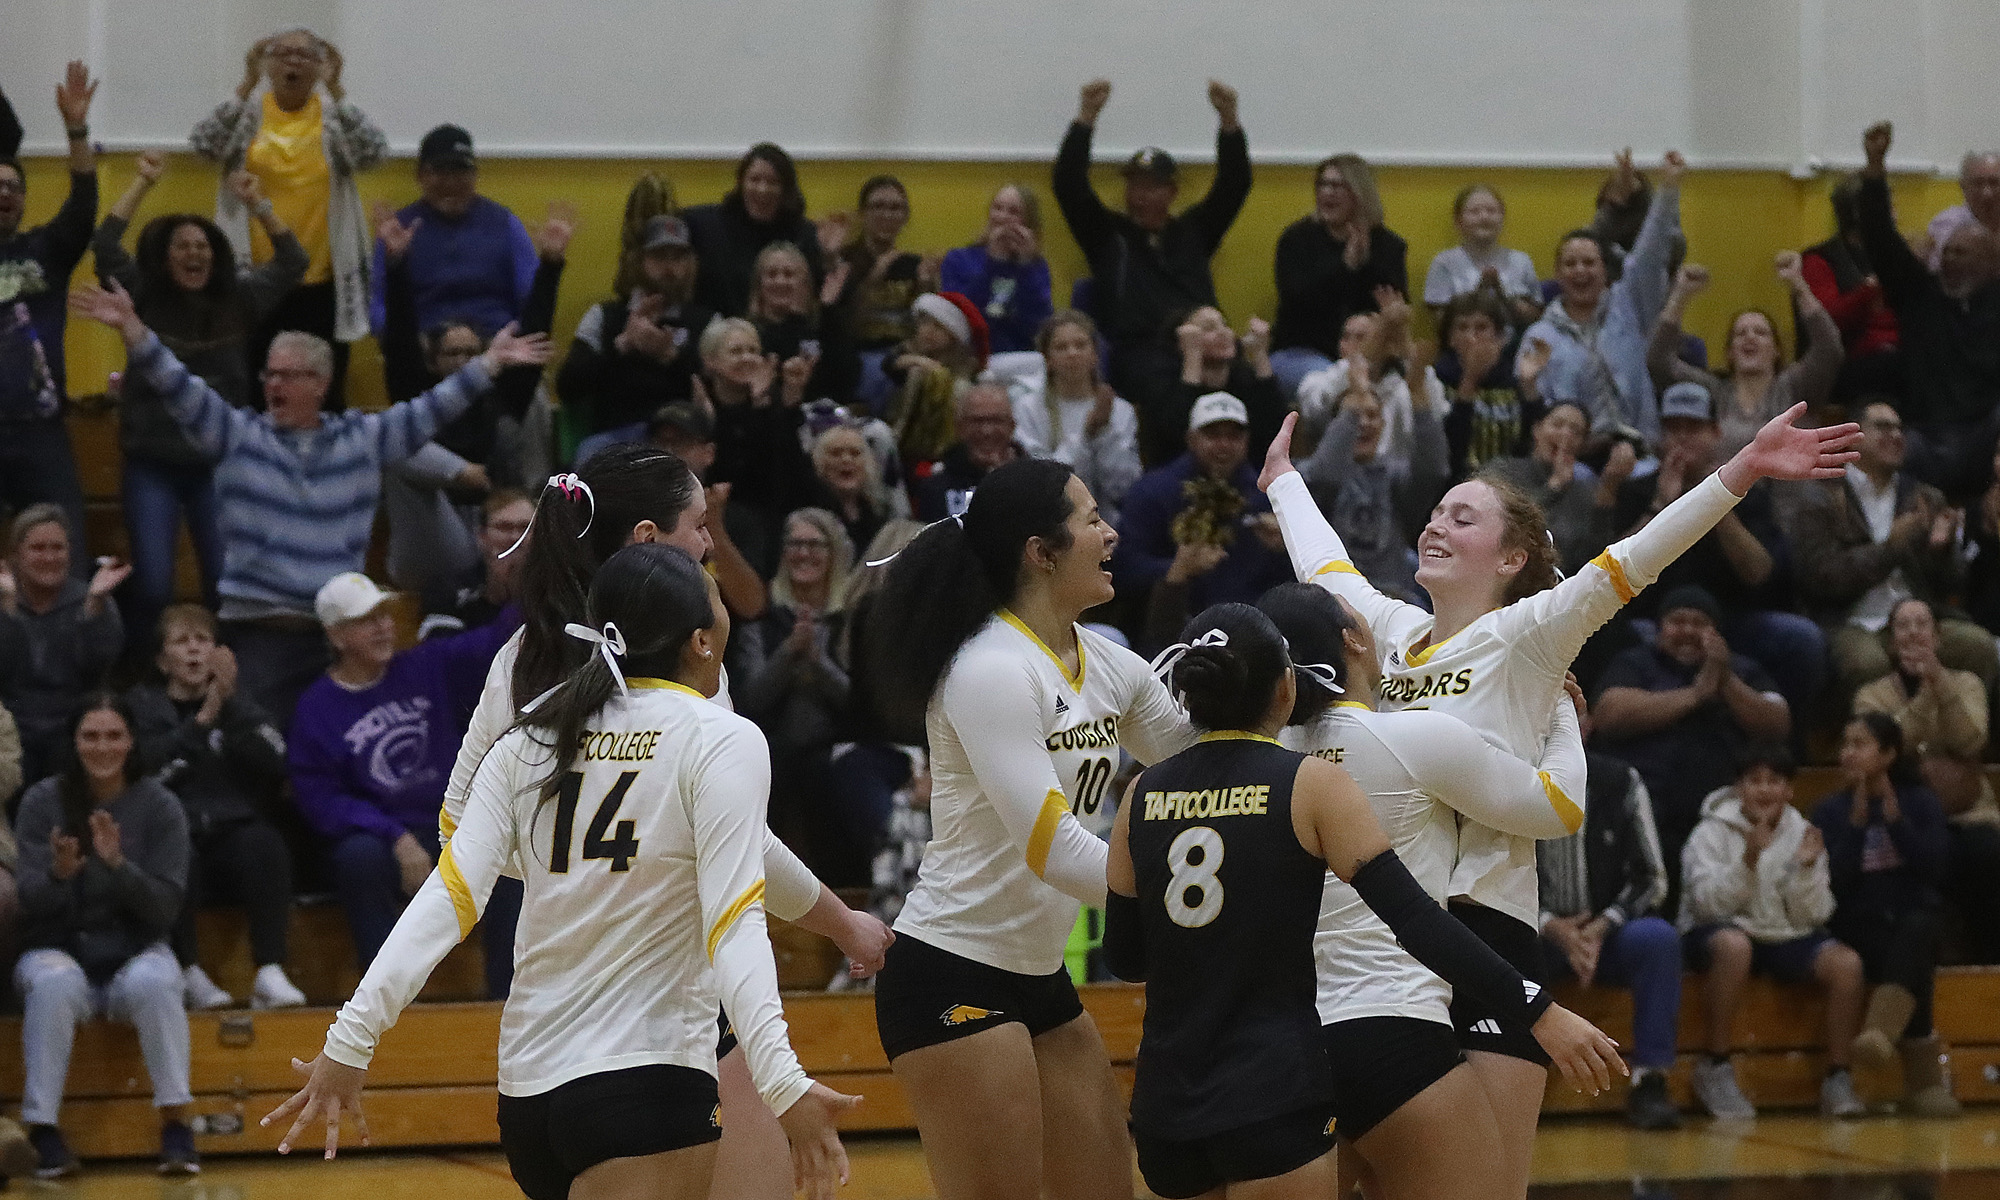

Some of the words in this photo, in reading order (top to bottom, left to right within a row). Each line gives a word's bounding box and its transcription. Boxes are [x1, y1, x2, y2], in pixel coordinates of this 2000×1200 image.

[1045, 715, 1119, 751] COUGAR
[548, 771, 640, 874] 14
[1071, 757, 1111, 816] 10
[1164, 826, 1225, 928] 8
